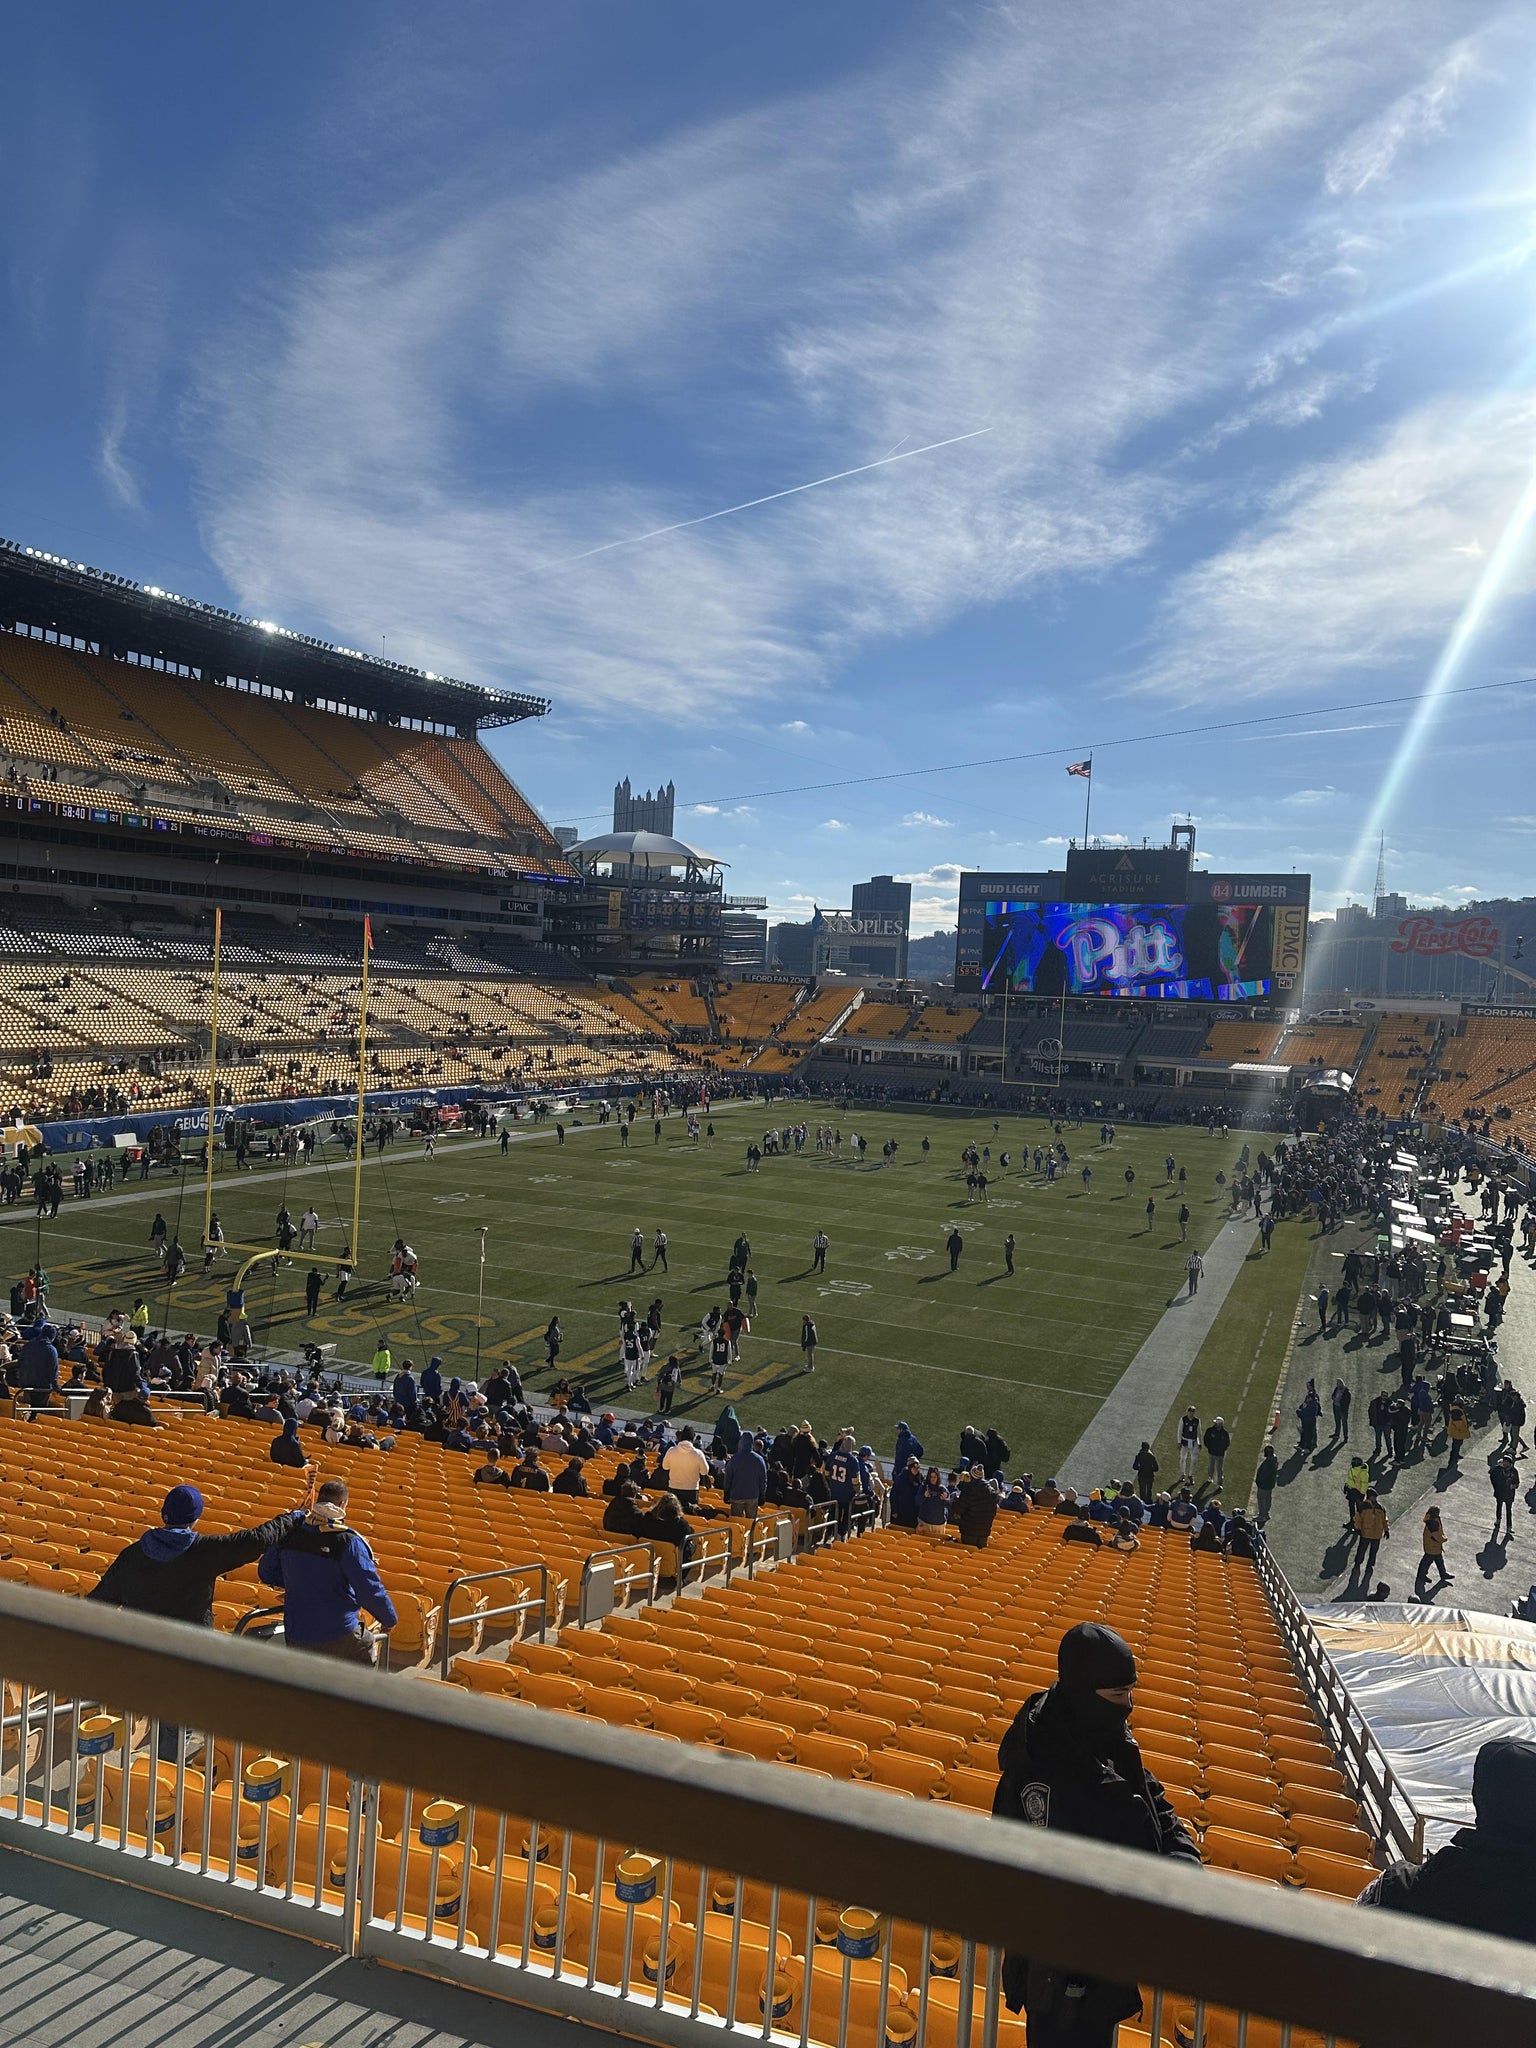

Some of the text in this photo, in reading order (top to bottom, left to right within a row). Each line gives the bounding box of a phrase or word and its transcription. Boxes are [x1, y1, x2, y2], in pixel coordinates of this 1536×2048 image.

[62, 805, 86, 819] 58:40
[109, 813, 119, 823] 1ST
[194, 826, 208, 836] THE
[209, 828, 244, 842] OFFICIAL
[246, 835, 274, 846] HEALTH
[275, 838, 294, 849] CARE
[295, 841, 329, 854] PROVIDER
[331, 847, 346, 856] AND
[347, 849, 372, 860] HEALTH
[373, 853, 390, 862] PLAN
[390, 854, 400, 863] OF
[400, 856, 413, 865] THE
[487, 867, 509, 878] UPMC
[1089, 874, 1162, 884] ACRISURE
[980, 884, 1041, 895] BUD LIGHT
[1213, 885, 1288, 898] 84 LUMBER
[507, 901, 532, 912] UPMC
[969, 908, 985, 916] PNC
[826, 918, 904, 936] PEOPLES
[967, 928, 984, 936] PNC
[1281, 910, 1302, 969] UPMC
[967, 948, 982, 956] PNC
[1056, 916, 1184, 984] Pitt
[751, 974, 811, 985] FORD FAN ZONE
[1216, 1011, 1238, 1020] Ford
[1477, 1008, 1534, 1018] FORD FAN
[1030, 1057, 1070, 1075] Allstate
[174, 1116, 200, 1131] GBU
[884, 1245, 936, 1261] 20
[816, 1279, 873, 1297] 10
[716, 1342, 726, 1352] 18
[831, 1464, 847, 1483] 13
